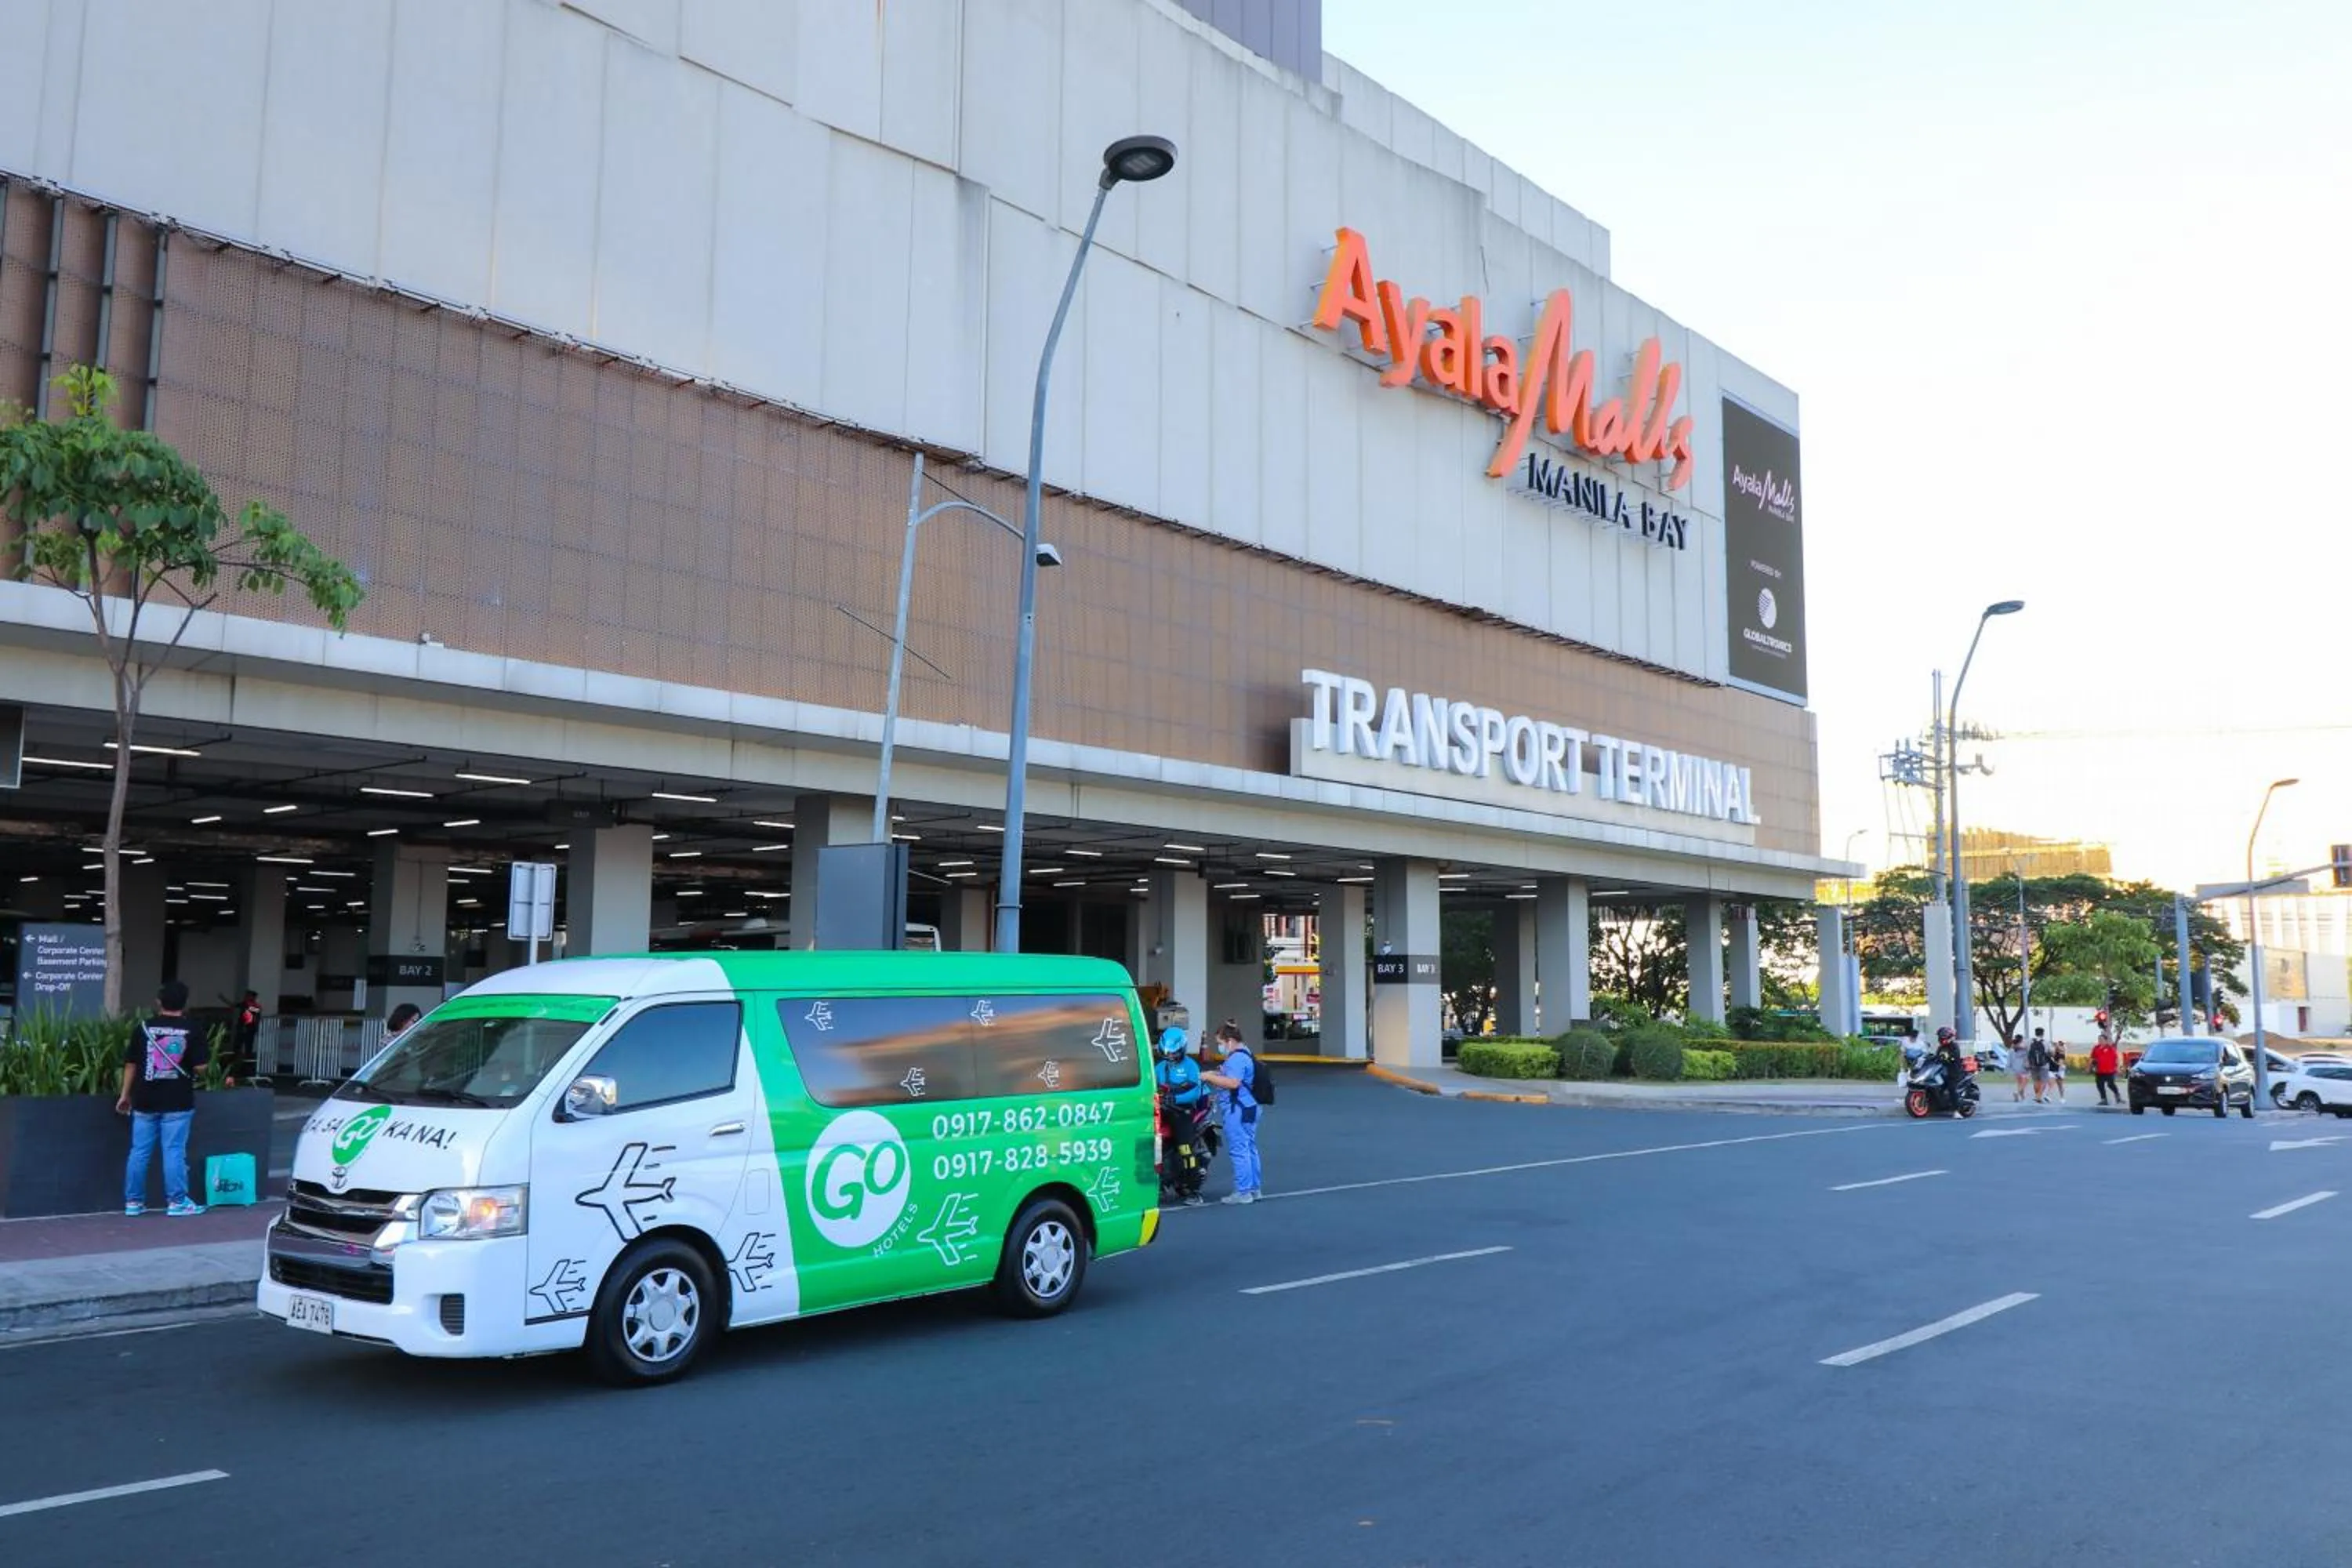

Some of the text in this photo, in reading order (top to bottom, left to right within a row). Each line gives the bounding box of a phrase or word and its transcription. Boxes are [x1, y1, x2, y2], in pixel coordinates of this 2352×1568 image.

[1313, 226, 1694, 492] Ayala Malls
[1529, 452, 1688, 550] MANILA BAY
[1733, 463, 1795, 514] Ayala Malls
[1301, 669, 1761, 826] TRANSPORT TERMINAL
[37, 945, 105, 956] Corporate Center
[37, 956, 78, 965] Basement
[1377, 964, 1404, 974] BAY 3
[34, 982, 71, 993] Drop-Off
[35, 971, 103, 982] Corporate Center
[399, 965, 433, 977] BAY 2
[336, 1115, 385, 1150] GO
[932, 1101, 1114, 1140] 0917-862-0847
[934, 1138, 1112, 1179] 0917-828-5939
[811, 1140, 906, 1221] GO
[873, 1203, 918, 1258] HOTELS
